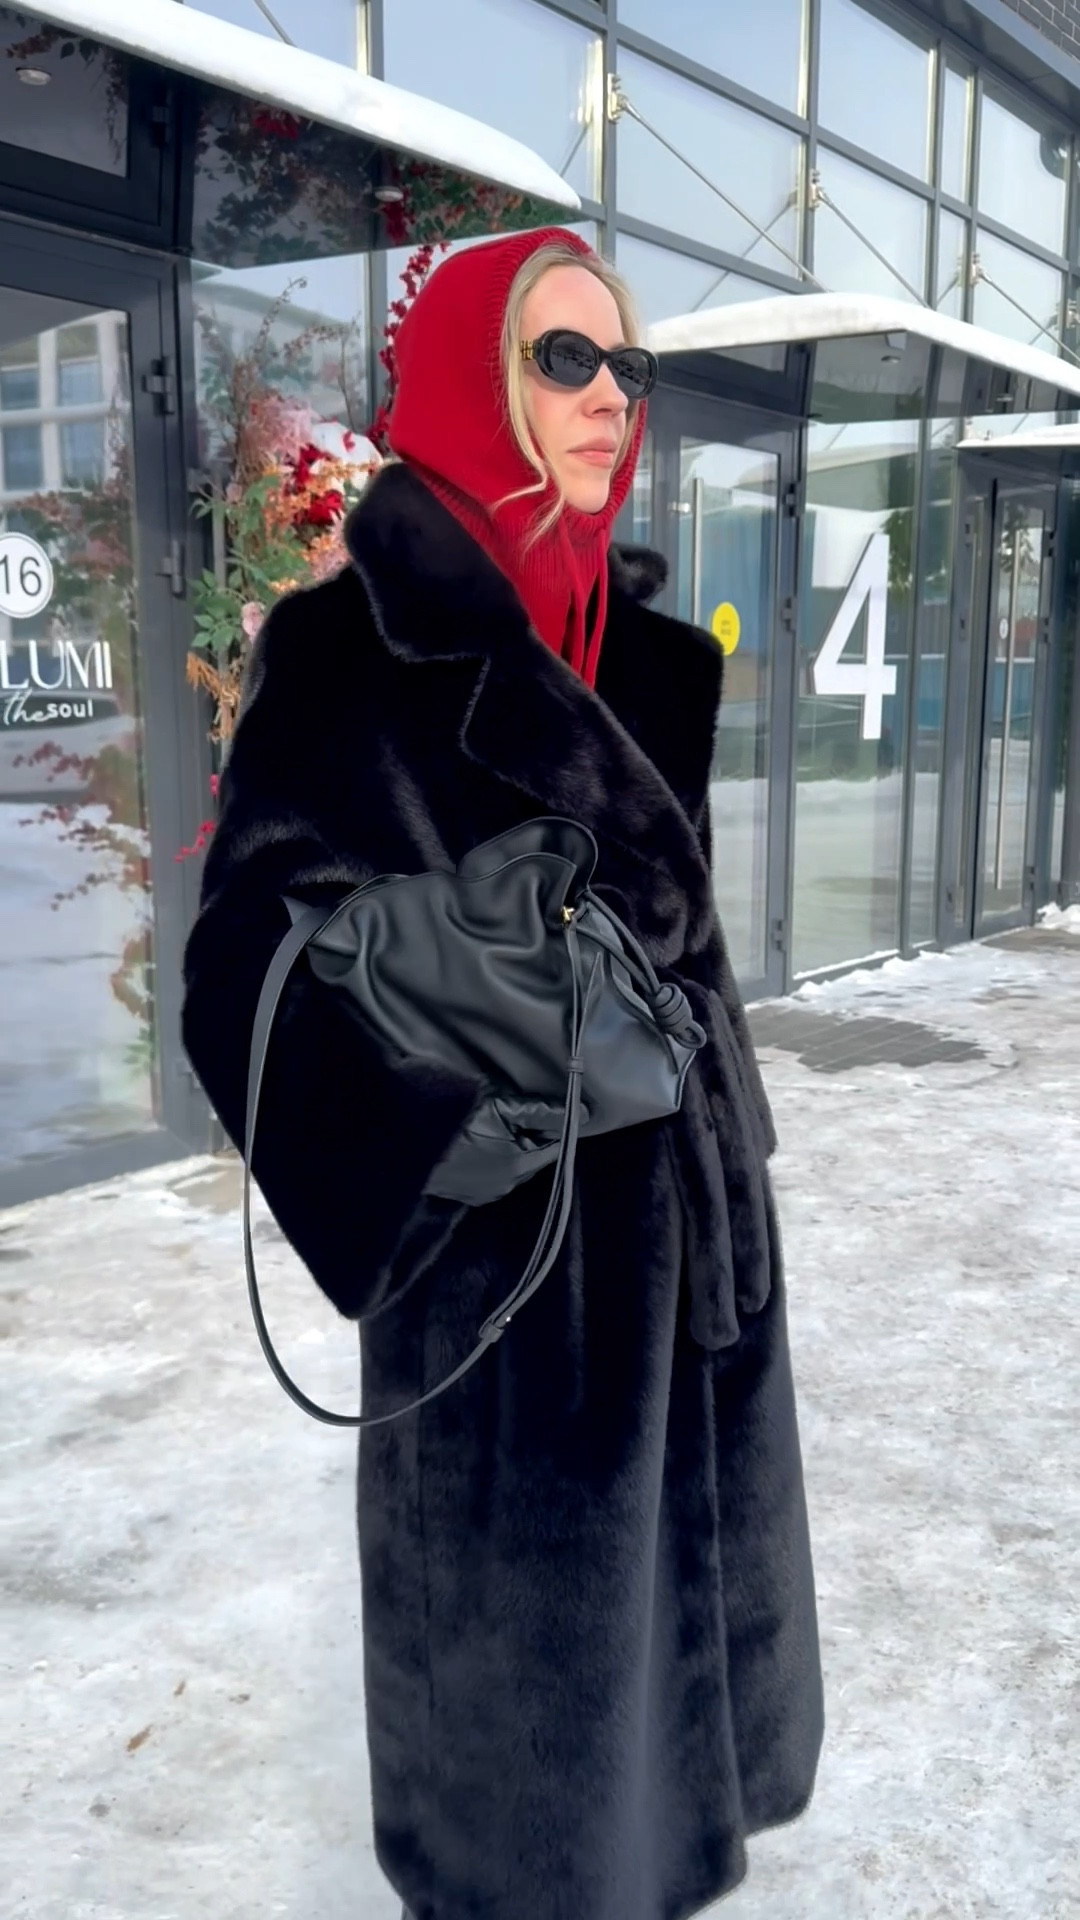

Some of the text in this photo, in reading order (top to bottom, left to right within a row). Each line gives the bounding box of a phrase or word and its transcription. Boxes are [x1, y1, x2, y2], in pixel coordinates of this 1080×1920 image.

[0, 555, 42, 596] 16
[813, 532, 897, 740] 4
[47, 699, 93, 718] soul
